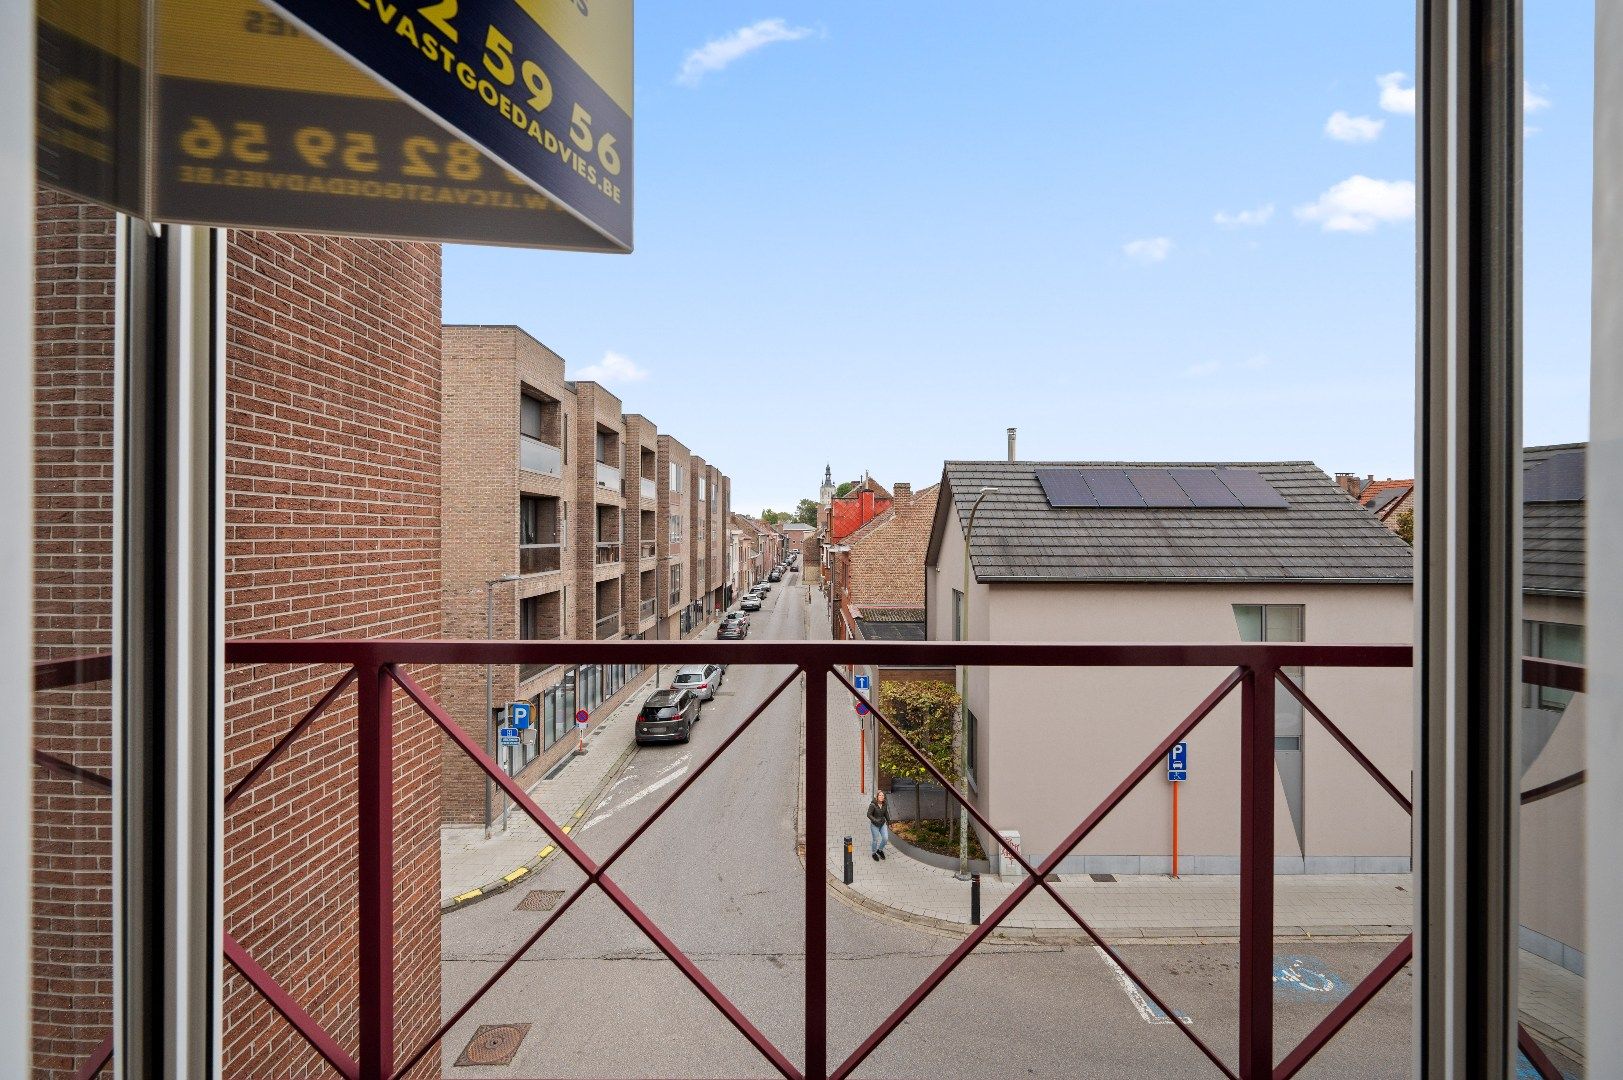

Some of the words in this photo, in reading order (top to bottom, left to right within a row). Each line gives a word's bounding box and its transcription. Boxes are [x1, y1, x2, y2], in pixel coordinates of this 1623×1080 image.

[356, 0, 621, 204] VASTGOEDADVIES.BE
[482, 24, 553, 113] 59
[569, 102, 621, 176] 56
[514, 707, 527, 725] P
[1172, 744, 1183, 760] P
